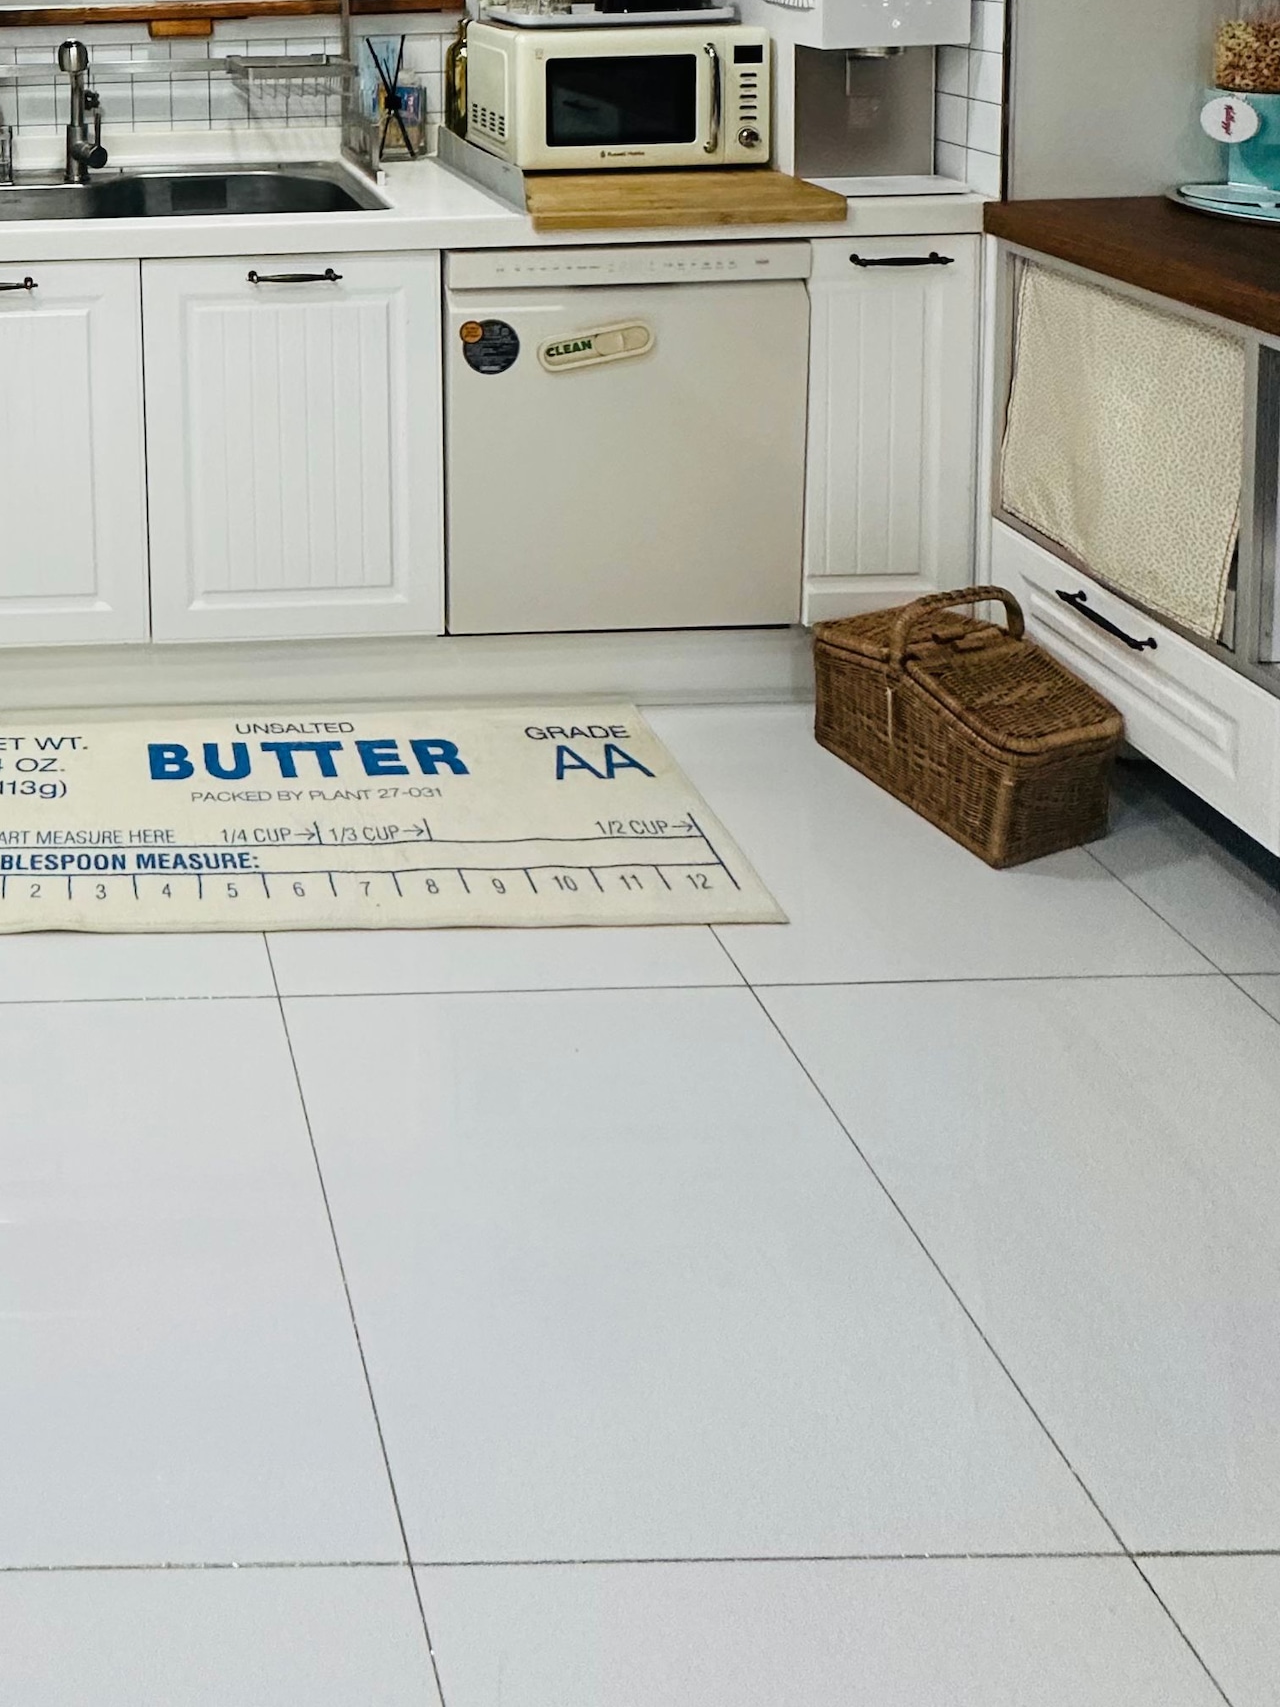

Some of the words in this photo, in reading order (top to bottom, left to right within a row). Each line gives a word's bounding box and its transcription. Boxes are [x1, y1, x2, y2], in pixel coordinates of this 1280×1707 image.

[545, 339, 593, 358] CLEAN
[235, 722, 355, 735] UNSALTED
[524, 725, 631, 740] GRADE
[34, 736, 88, 750] WT.
[15, 758, 66, 772] OZ.
[147, 739, 470, 780] BUTTER
[556, 743, 656, 780] AA
[191, 791, 271, 803] PACKED
[276, 791, 303, 802] BY
[308, 789, 373, 801] PLANT
[377, 787, 443, 799] 27-031
[220, 828, 247, 843] 1/4
[253, 828, 291, 842] CUP
[328, 827, 357, 842] 1/3
[363, 824, 399, 841] CUP
[594, 820, 626, 835] 1/2
[629, 820, 668, 835] CUP
[36, 829, 122, 845] MEASURE
[129, 829, 175, 844] HERE
[136, 852, 260, 871] MEASURE:
[30, 883, 42, 899] 2
[95, 884, 107, 900] 3
[161, 883, 174, 898] 4
[227, 882, 238, 899] 5
[292, 882, 305, 898] 6
[360, 881, 371, 896] 7
[426, 878, 439, 894] 8
[491, 878, 506, 895] 9
[551, 875, 578, 892] 10
[619, 874, 644, 890] 11
[685, 873, 714, 891] 12
